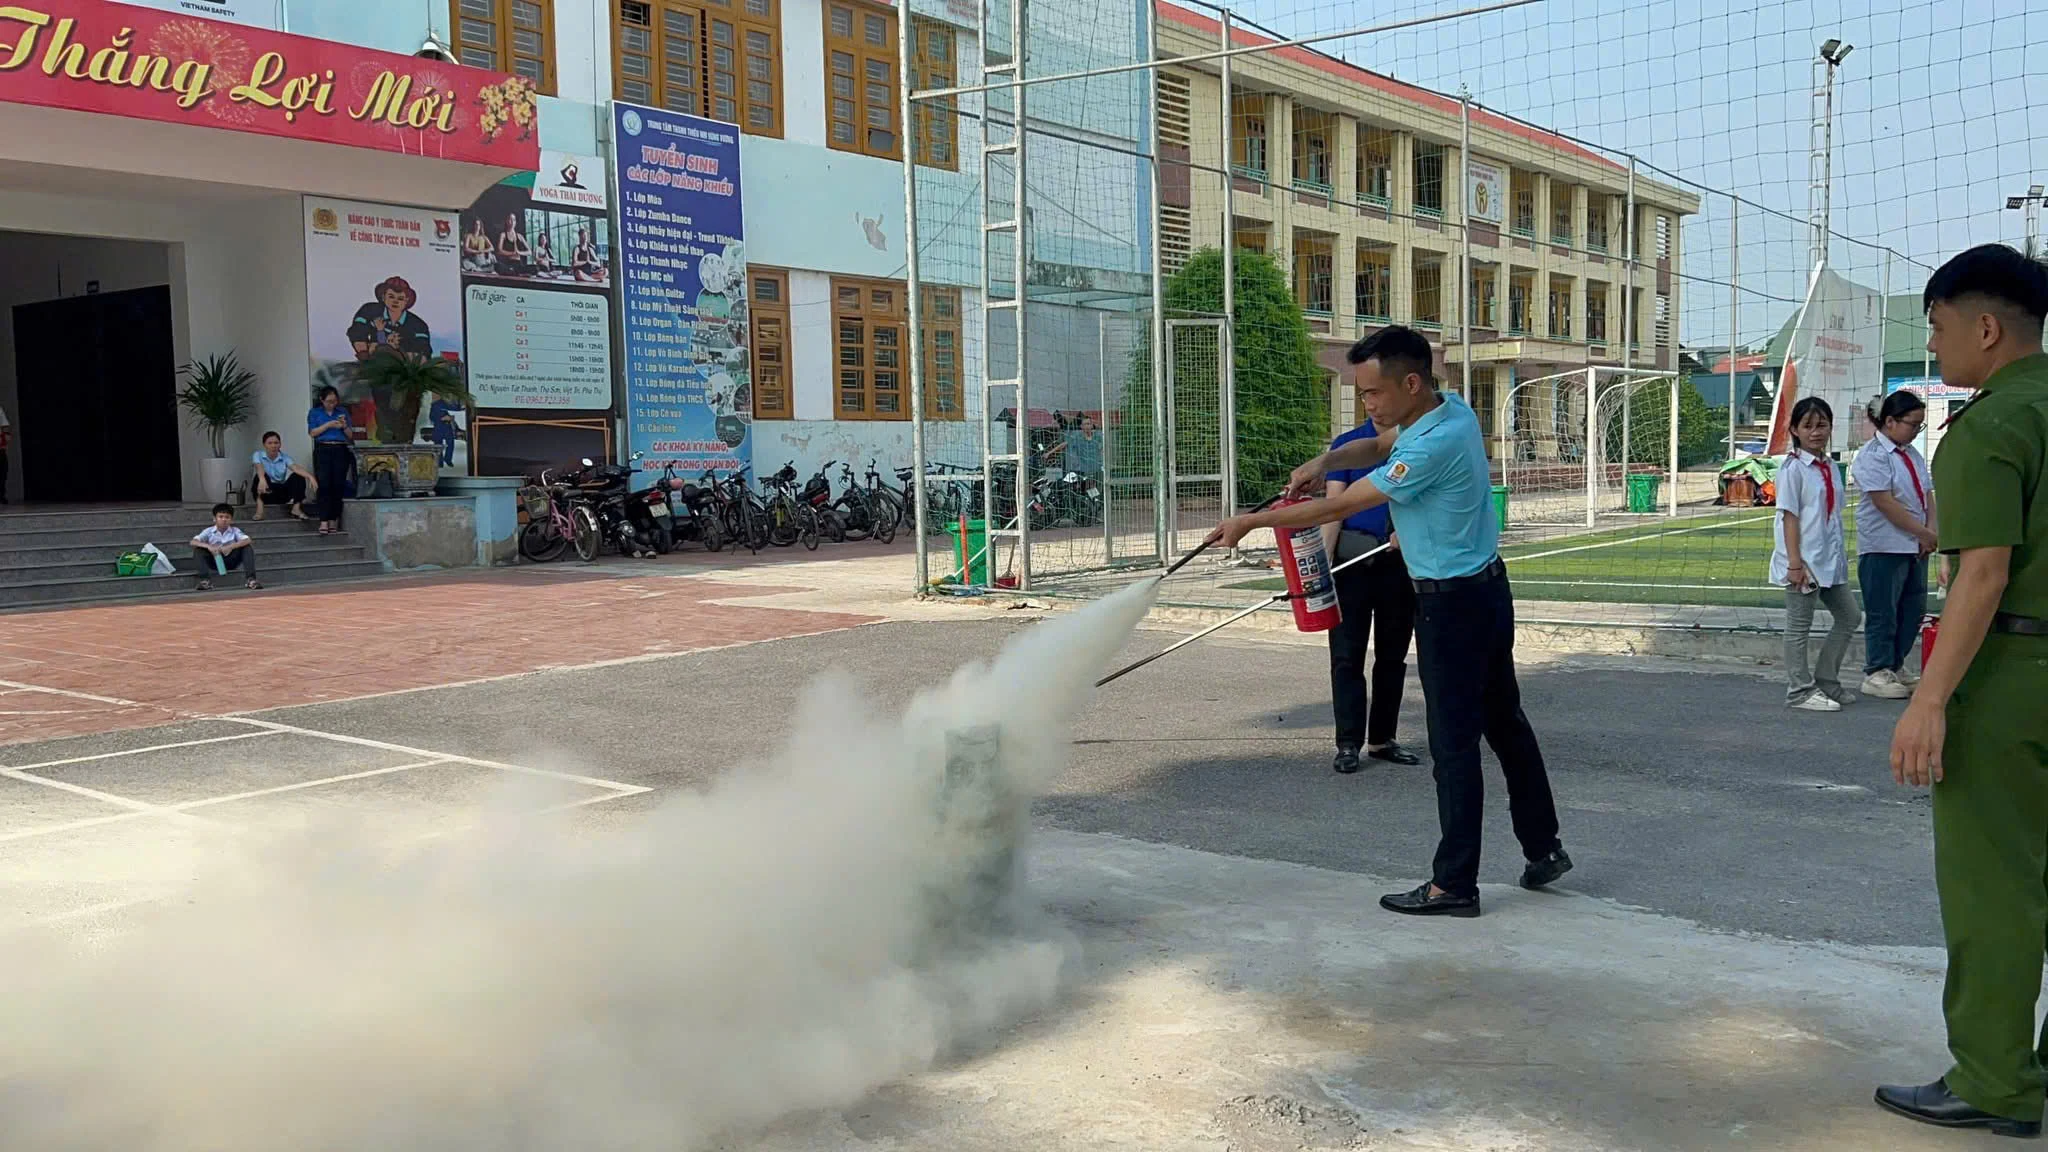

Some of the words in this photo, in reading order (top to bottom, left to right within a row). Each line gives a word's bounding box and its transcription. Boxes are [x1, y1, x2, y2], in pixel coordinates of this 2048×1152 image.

[181, 1, 210, 12] VIETNAM
[211, 7, 235, 17] SAFETY
[0, 6, 213, 107] Thắng
[229, 52, 336, 123] Lợi
[349, 70, 456, 132] Mới
[642, 142, 685, 169] TUYỂN
[686, 155, 718, 175] SINH
[627, 164, 649, 181] CÁC
[649, 168, 671, 186] LỚP
[703, 177, 733, 196] KHIẾU
[540, 187, 558, 199] YOGA
[627, 207, 633, 216] 2.
[648, 210, 670, 222] Zumba
[672, 214, 691, 224] Dance
[627, 223, 634, 232] 3.
[667, 228, 681, 239] hiện
[682, 230, 692, 242] đại
[628, 238, 634, 248] 4.
[690, 247, 704, 256] thao
[629, 254, 635, 263] 5.
[650, 256, 670, 267] Thanh
[671, 259, 688, 270] Nhạc
[629, 269, 636, 279] 6.
[651, 271, 662, 281] MC
[630, 285, 637, 294] 7.
[666, 289, 685, 298] Guitar
[653, 318, 672, 328] Organ
[688, 395, 704, 403] THCS
